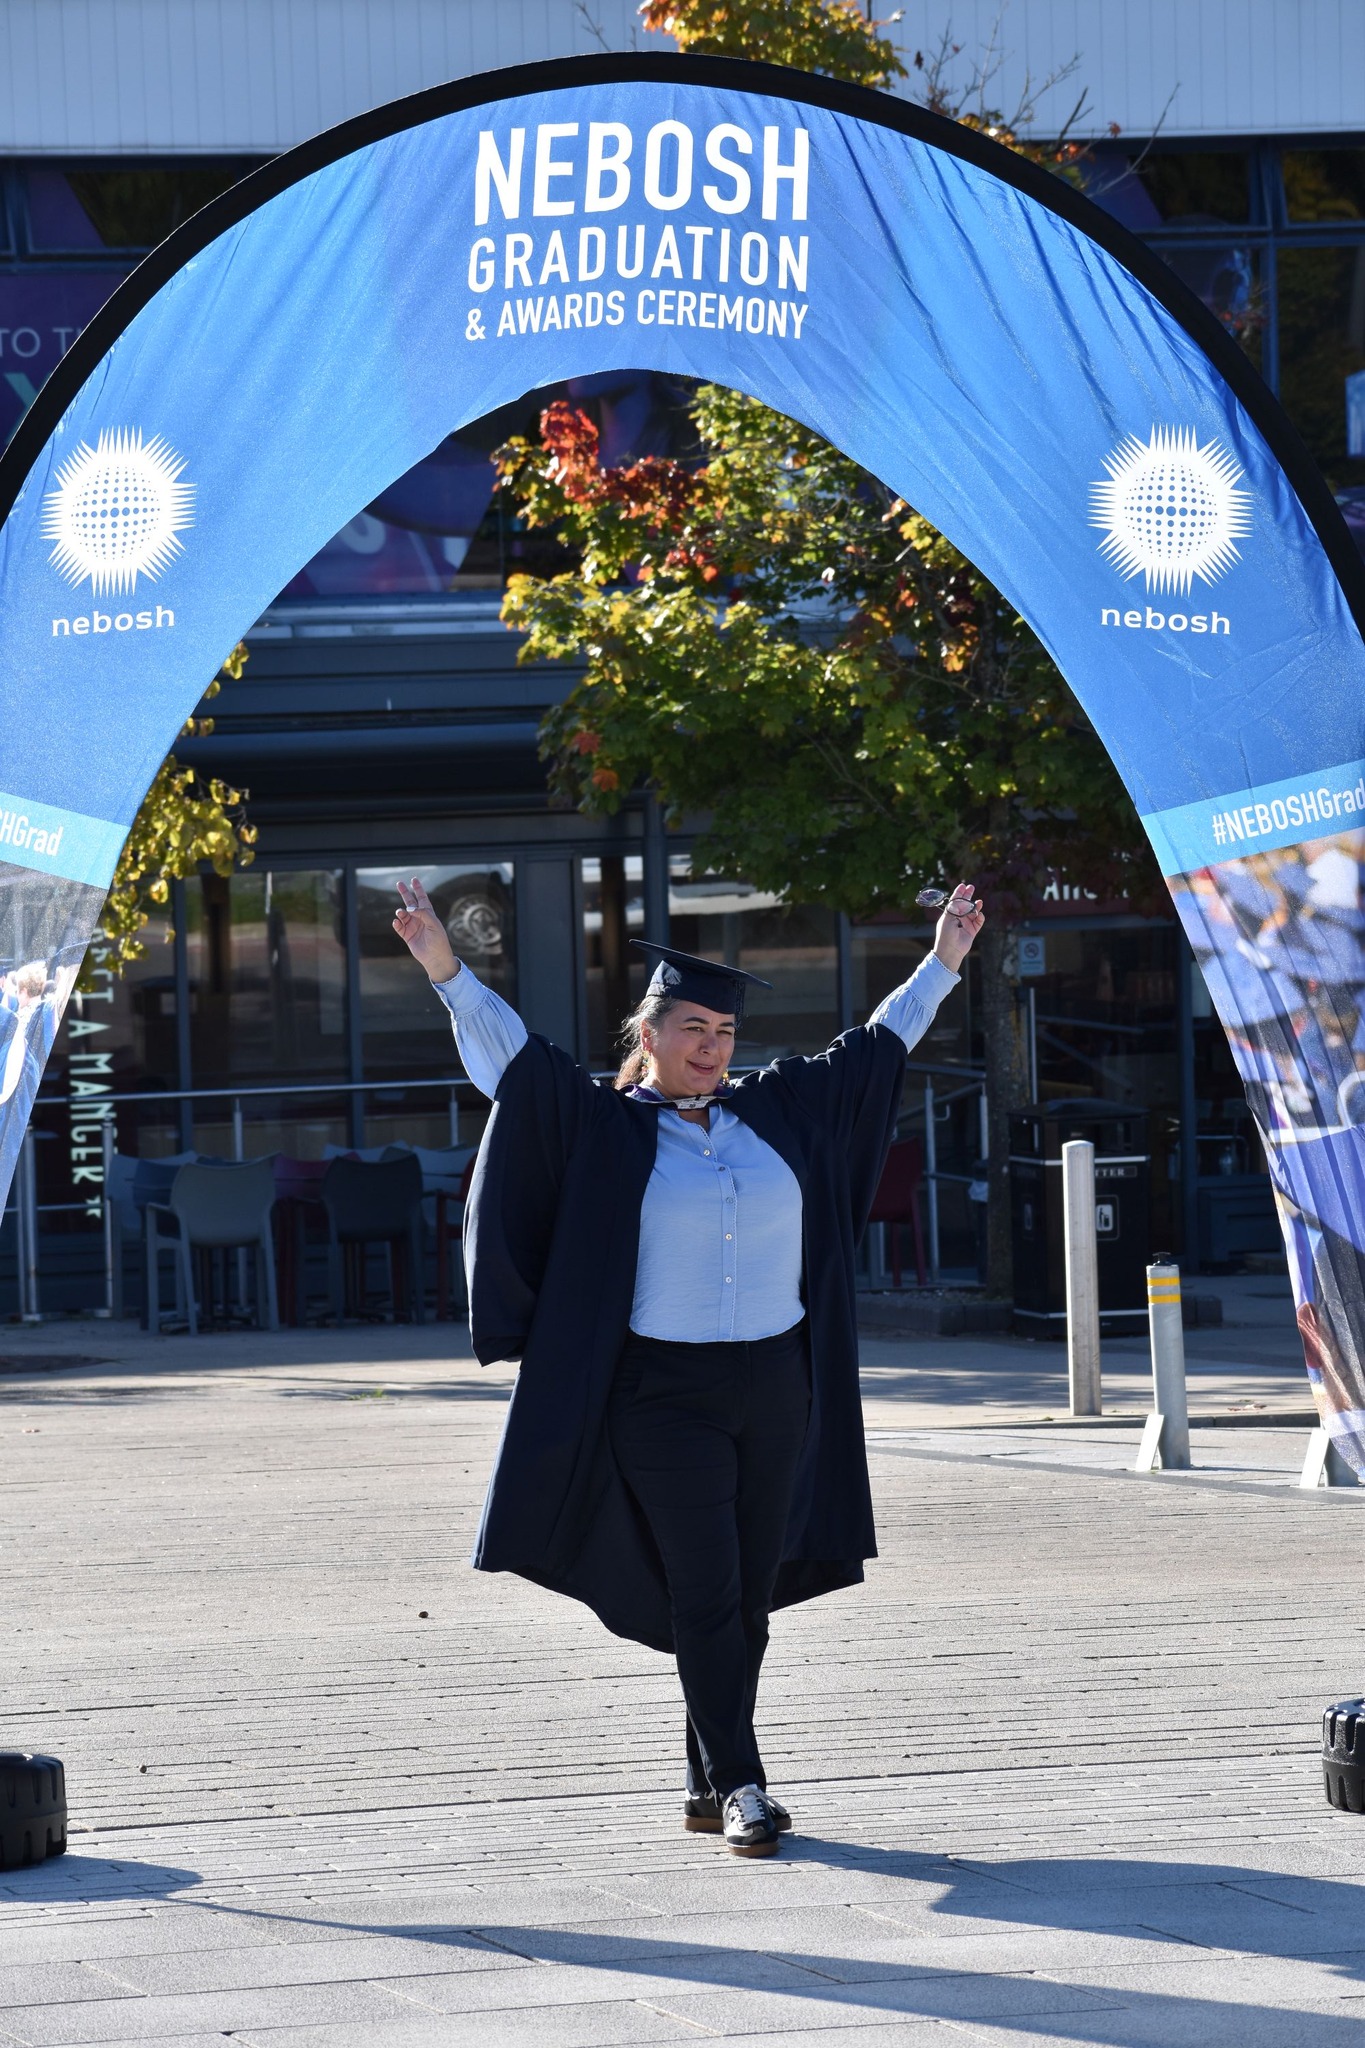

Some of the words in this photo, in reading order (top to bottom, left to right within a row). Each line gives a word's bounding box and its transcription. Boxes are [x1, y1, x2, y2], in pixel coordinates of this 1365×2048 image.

[474, 119, 810, 227] NEBOSH
[467, 224, 809, 293] GRADUATION
[465, 308, 486, 343] &
[496, 290, 626, 338] AWARDS
[636, 289, 809, 341] CEREMONY
[51, 604, 175, 637] nebosh
[1101, 605, 1231, 636] nebosh
[1212, 777, 1365, 846] #NEBOSHGrad
[67, 1019, 112, 1038] A
